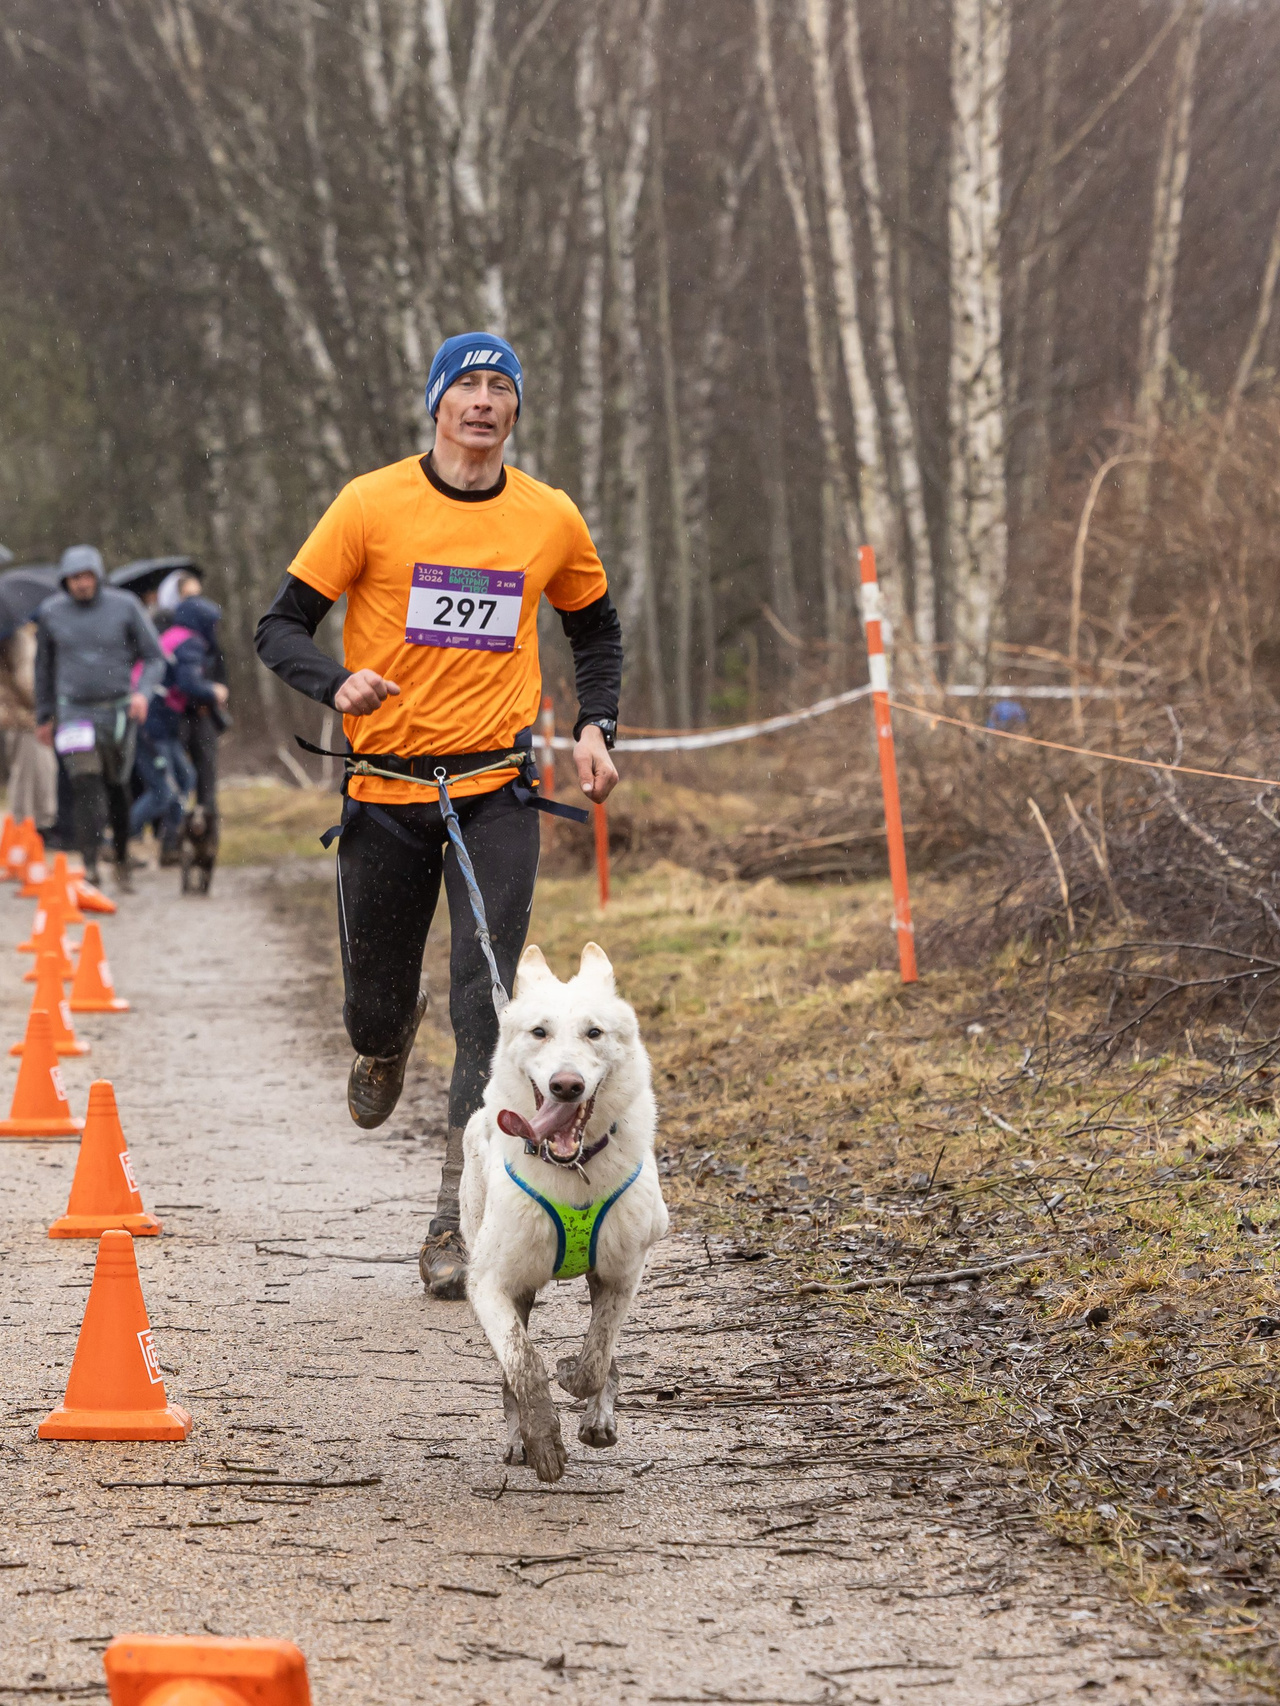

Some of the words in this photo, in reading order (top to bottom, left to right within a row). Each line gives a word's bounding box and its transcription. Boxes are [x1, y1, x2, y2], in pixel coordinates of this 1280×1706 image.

[419, 567, 443, 575] 11/04
[450, 568, 481, 578] КРОСС
[418, 574, 443, 583] 2026
[449, 576, 489, 586] БЫСТРЫЙ
[496, 580, 502, 588] 2
[433, 596, 497, 629] 297
